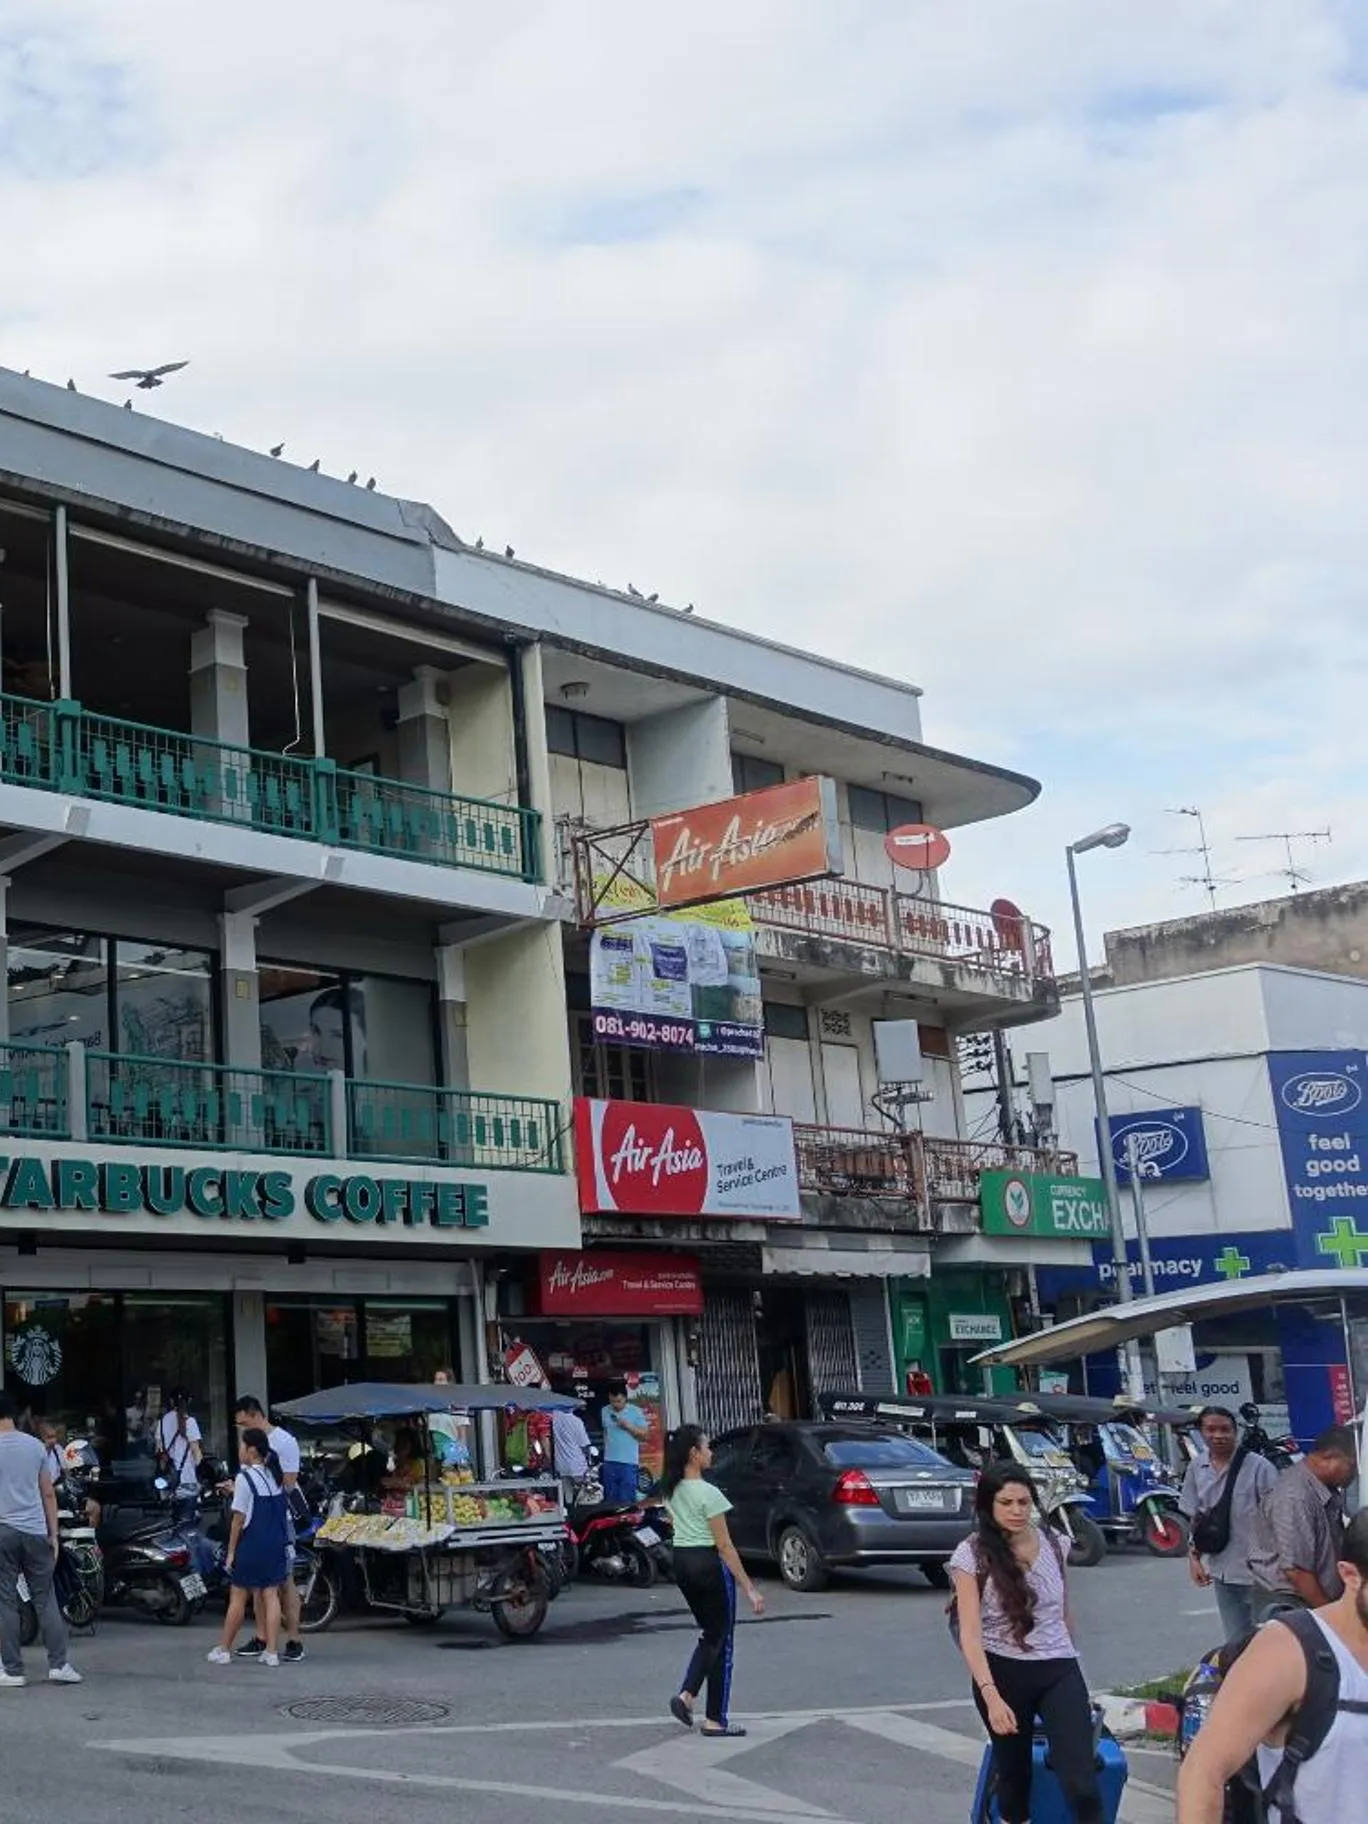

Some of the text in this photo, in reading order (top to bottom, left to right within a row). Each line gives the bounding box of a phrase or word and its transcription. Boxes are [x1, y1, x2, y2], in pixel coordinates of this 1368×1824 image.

[595, 1015, 695, 1046] 081-902-8074
[1292, 1079, 1348, 1108] Boots
[1307, 1131, 1352, 1151] feel
[716, 1156, 747, 1177] Travel
[1305, 1153, 1362, 1178] good
[716, 1164, 788, 1194] Service Centre
[1294, 1181, 1368, 1201] togethe
[304, 1174, 490, 1229] COFFEE
[1098, 1258, 1203, 1281] pamacy
[1200, 1380, 1240, 1398] good
